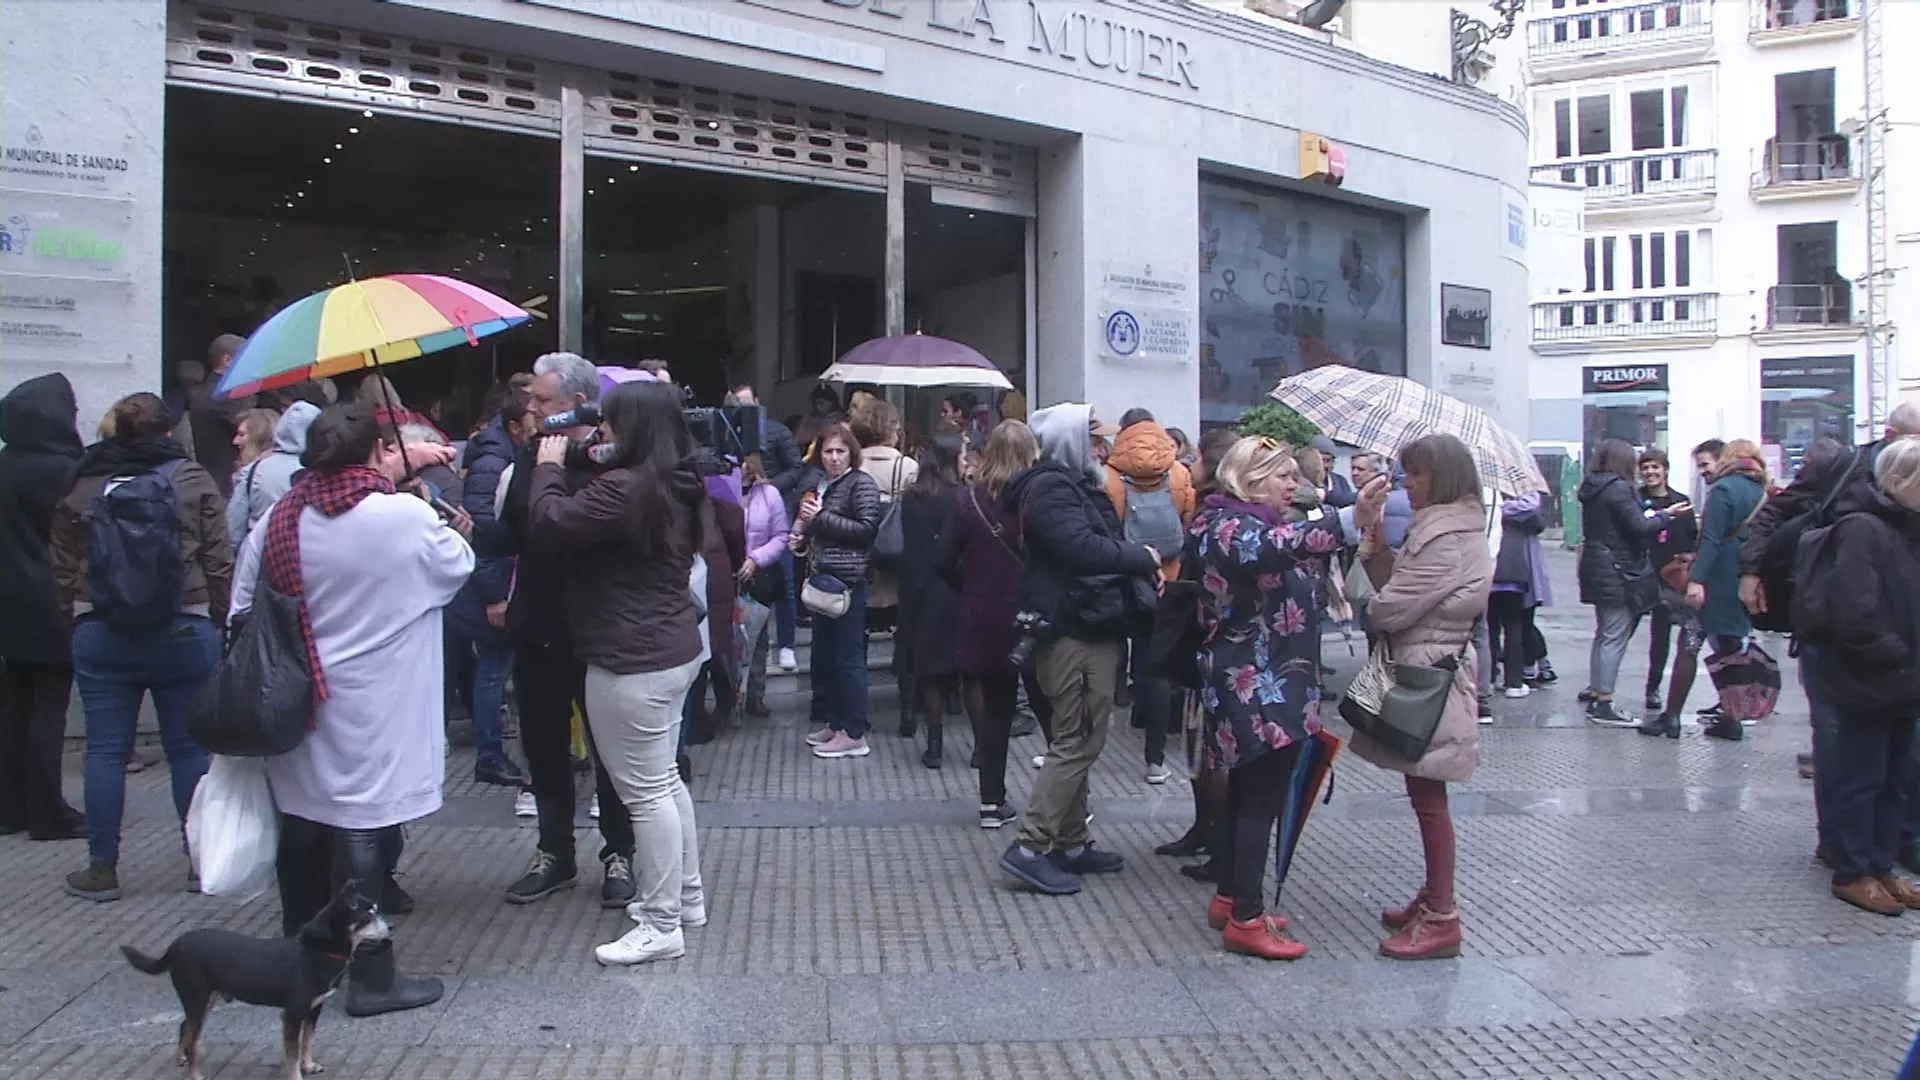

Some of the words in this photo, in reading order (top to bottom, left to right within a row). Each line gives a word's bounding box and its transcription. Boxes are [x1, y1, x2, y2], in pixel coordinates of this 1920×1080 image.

[927, 0, 1005, 43] LA
[1027, 1, 1199, 90] MUJER
[6, 148, 63, 165] MUNICIPAL
[66, 153, 79, 167] DE
[82, 155, 128, 171] SANIDAD
[1592, 367, 1659, 383] PRIMOR
